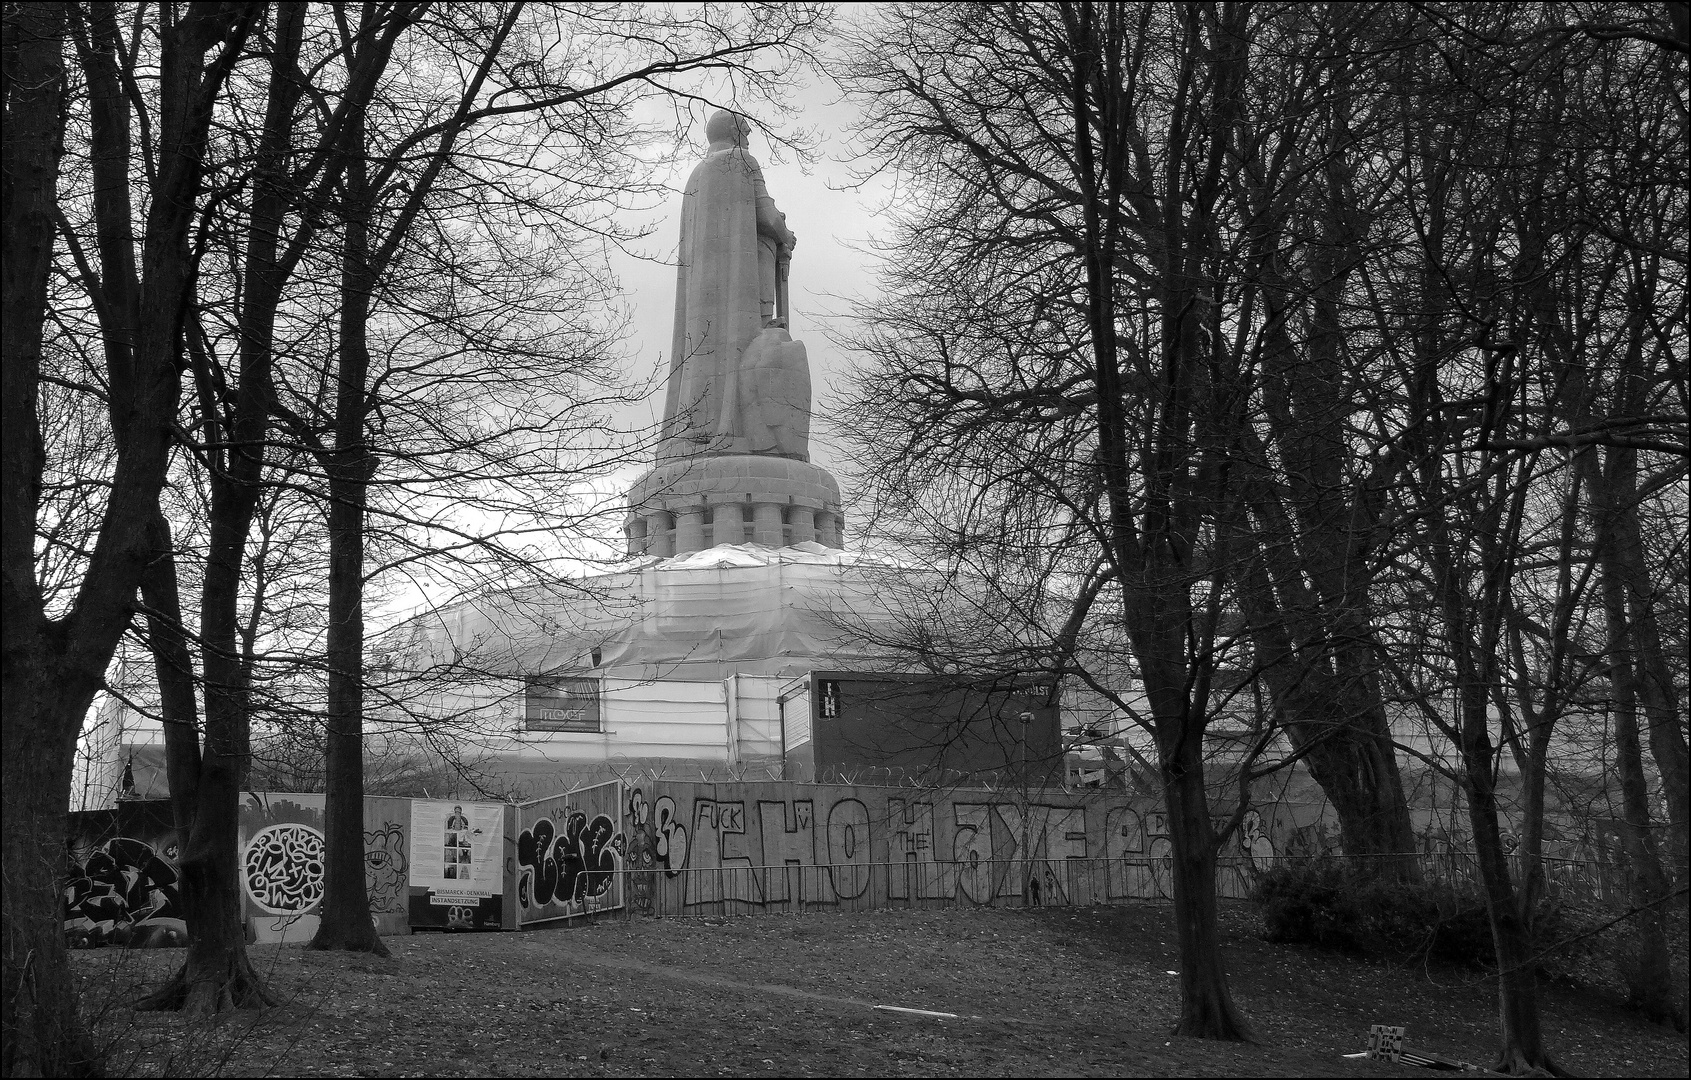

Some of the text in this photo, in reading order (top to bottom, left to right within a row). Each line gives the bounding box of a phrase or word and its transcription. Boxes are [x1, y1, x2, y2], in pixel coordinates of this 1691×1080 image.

[697, 804, 741, 831] FUCK
[896, 829, 930, 851] THE
[431, 897, 478, 905] INSTANDSETZUNG
